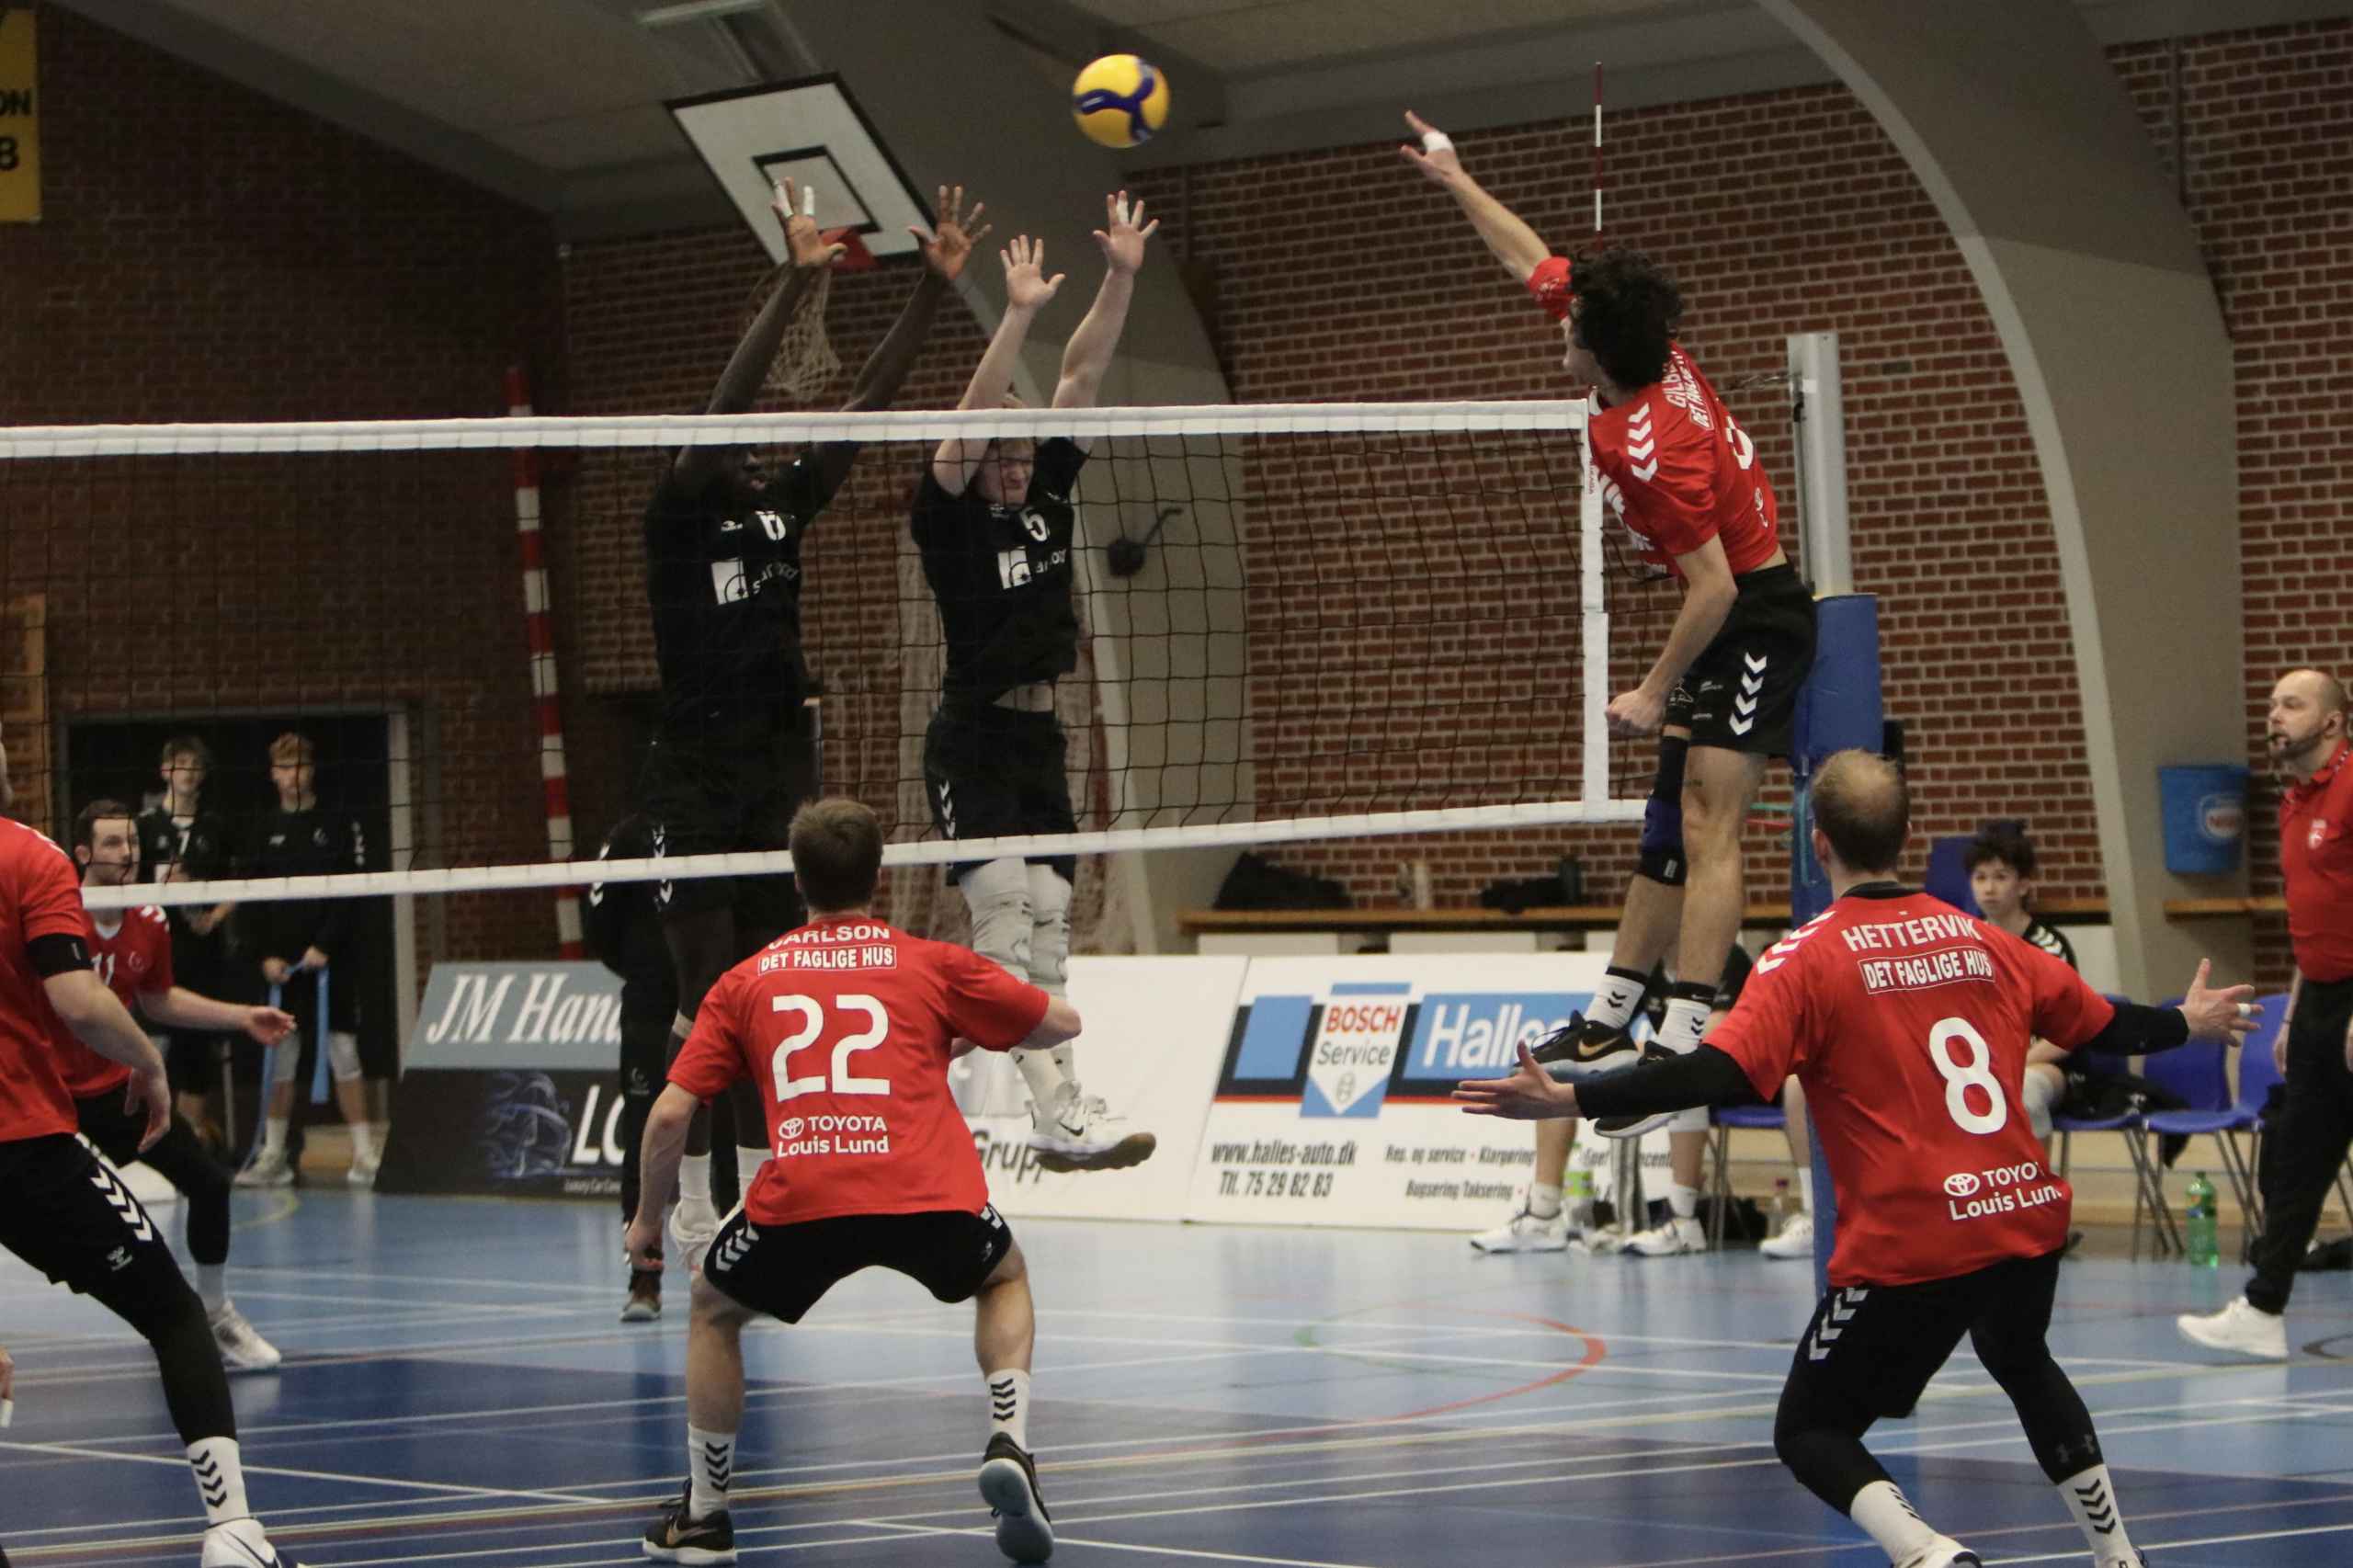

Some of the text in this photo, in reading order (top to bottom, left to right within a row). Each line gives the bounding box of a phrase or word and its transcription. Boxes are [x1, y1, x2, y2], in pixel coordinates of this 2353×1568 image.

[1841, 914, 1983, 952] HETTERVIK
[761, 947, 893, 972] DET FAGLIGE HUS
[1861, 950, 1994, 990] DET FAGLIGE HUS
[425, 973, 517, 1044] JM
[1325, 1005, 1403, 1035] BOSCH
[771, 994, 892, 1103] 22
[1317, 1040, 1392, 1067] Service
[1928, 1017, 2007, 1135] 8
[808, 1115, 888, 1133] TOYOTA
[777, 1134, 891, 1158] Louis Lund
[1211, 1139, 1358, 1165] www.halles-auto.dk
[1427, 1146, 1467, 1165] service
[1982, 1162, 2044, 1187] TOYO
[1949, 1185, 2062, 1221] Louis Lun
